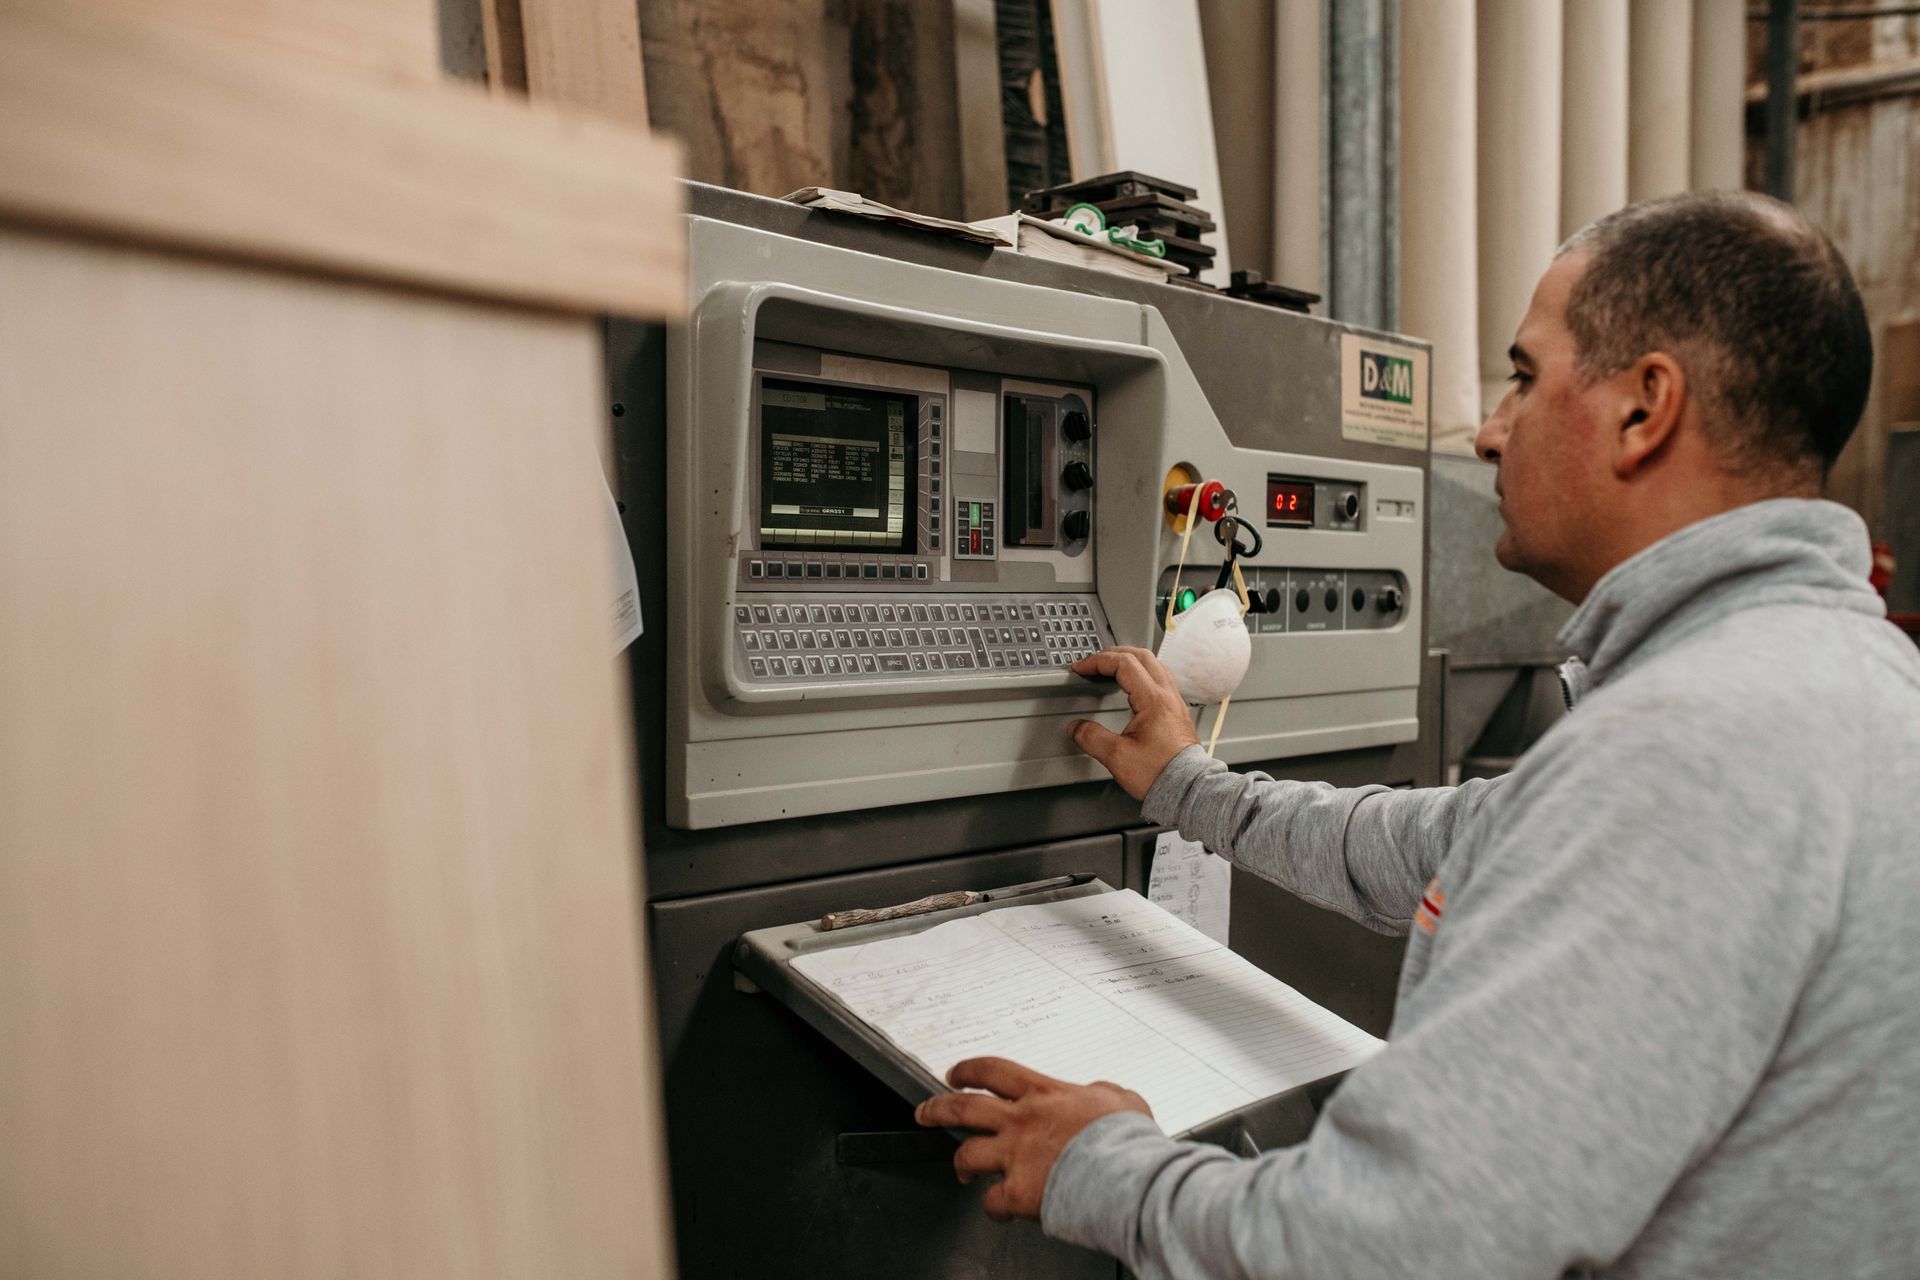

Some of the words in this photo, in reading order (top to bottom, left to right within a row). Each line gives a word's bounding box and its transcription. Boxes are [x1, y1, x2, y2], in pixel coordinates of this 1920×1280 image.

[1364, 358, 1410, 398] D&M
[757, 609, 765, 617] W
[765, 635, 772, 643] S
[821, 634, 828, 642] G
[792, 660, 798, 668] C
